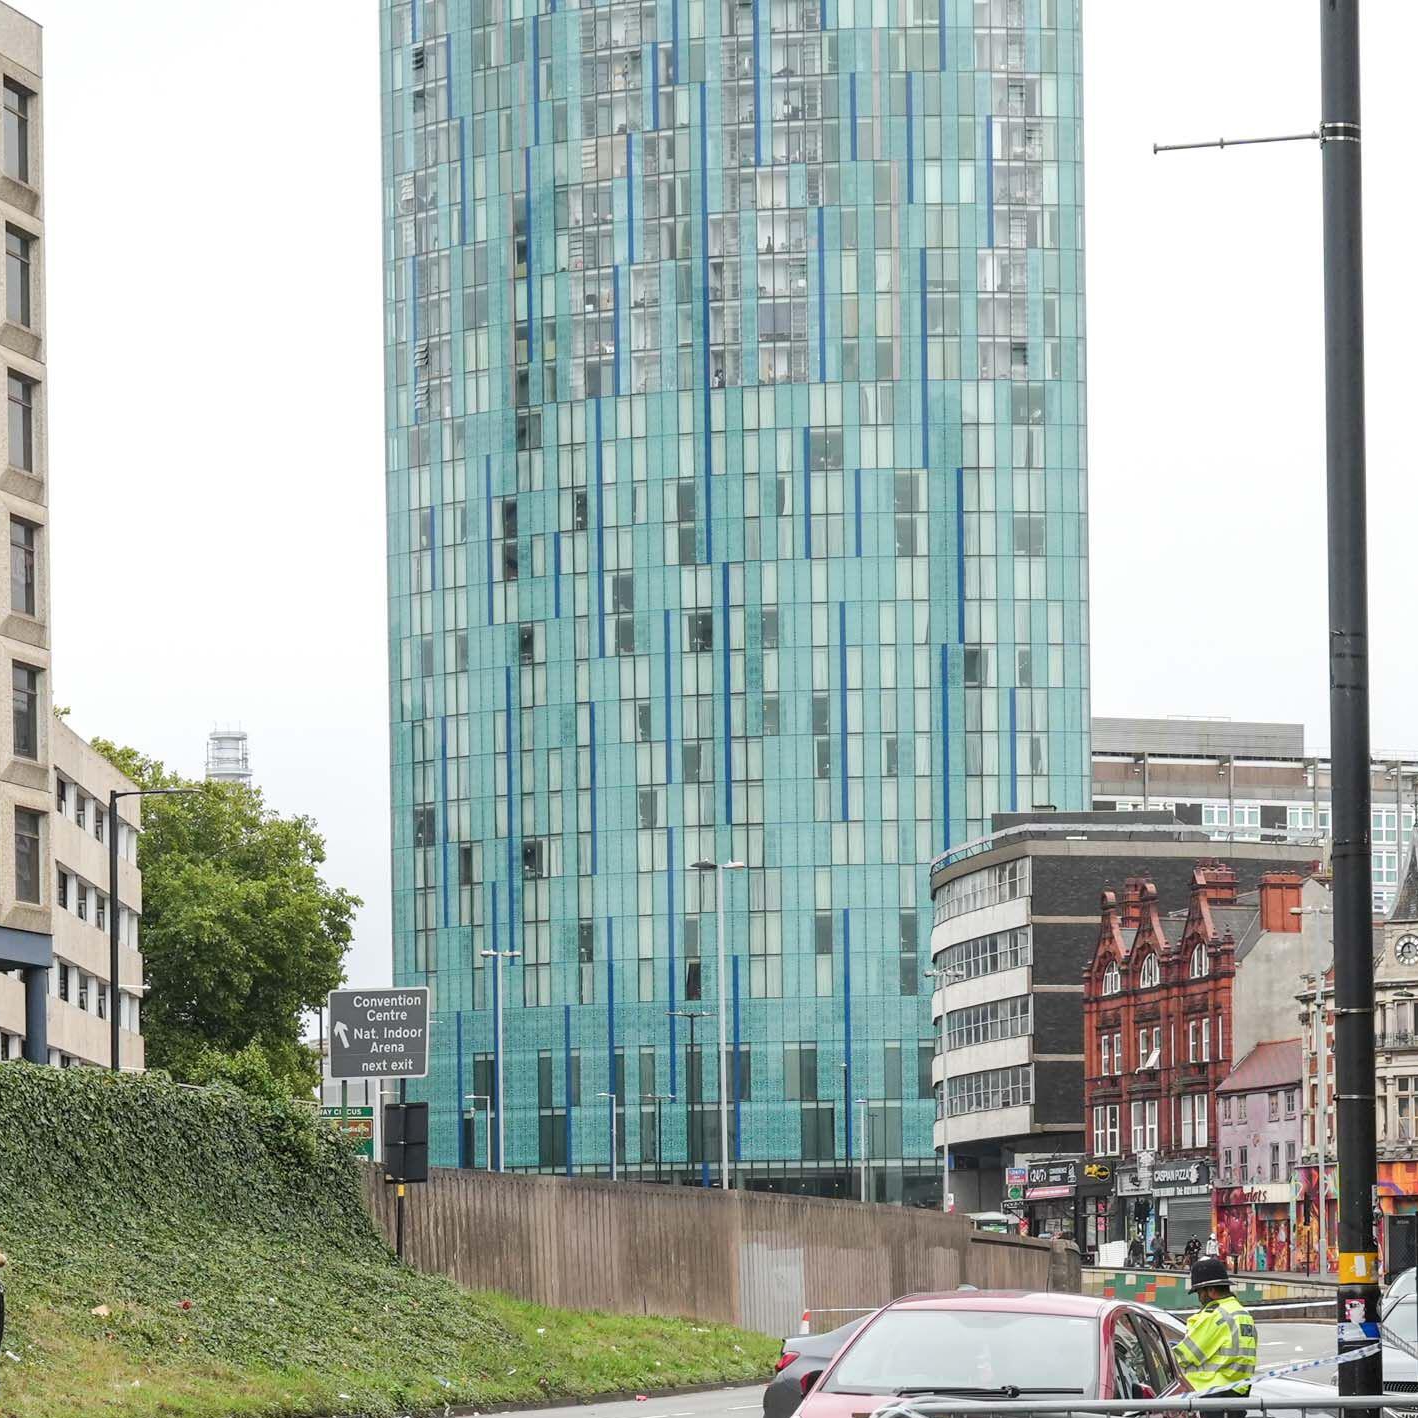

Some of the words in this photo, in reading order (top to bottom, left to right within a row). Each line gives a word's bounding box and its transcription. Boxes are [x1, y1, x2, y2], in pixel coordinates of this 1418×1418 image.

[353, 995, 421, 1007] Convention
[366, 1009, 408, 1021] Centre
[353, 1028, 379, 1039] Nat.
[384, 1027, 422, 1038] Indoor
[370, 1042, 405, 1053] Arena
[362, 1061, 388, 1071] next
[391, 1059, 413, 1070] exit
